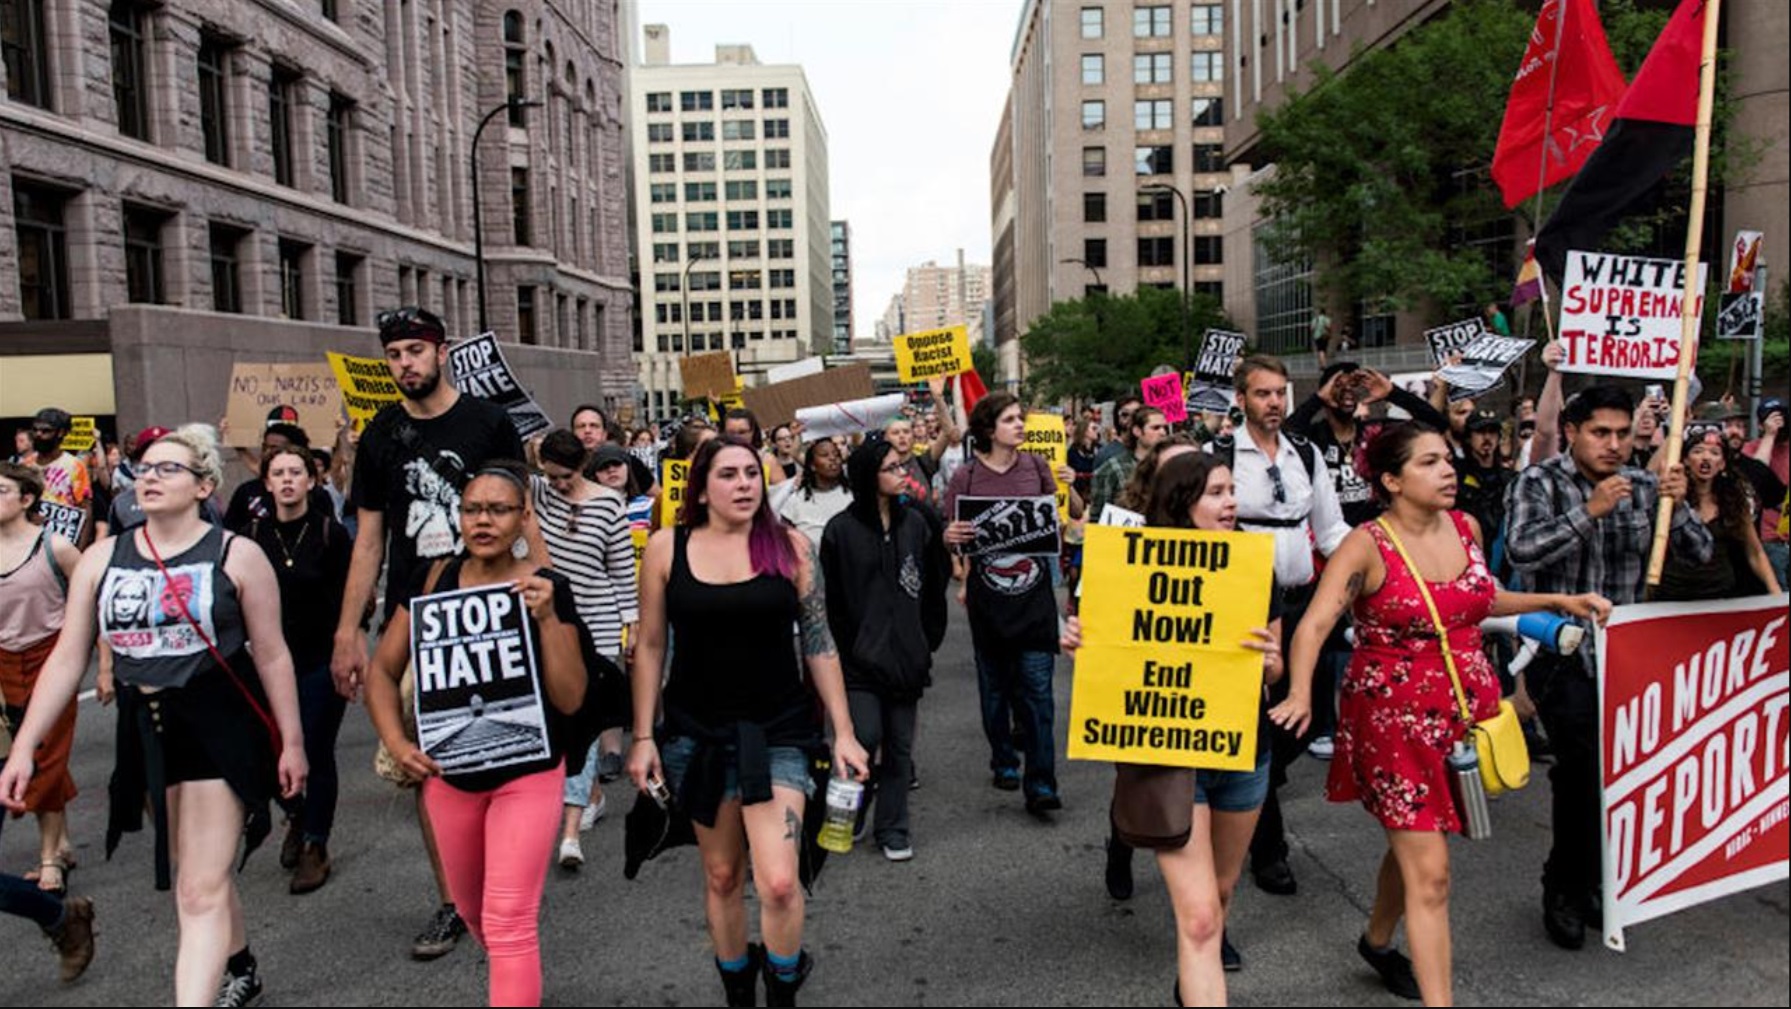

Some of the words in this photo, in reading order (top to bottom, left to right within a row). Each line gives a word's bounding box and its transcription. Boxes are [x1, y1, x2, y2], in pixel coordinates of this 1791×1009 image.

[1581, 255, 1687, 289] WHITE
[1433, 323, 1478, 350] STOP
[1605, 315, 1641, 336] IS
[907, 331, 955, 350] Oppose
[913, 346, 952, 363] Racist
[1207, 334, 1244, 354] STOP
[1561, 330, 1697, 369] TERRORIS
[453, 340, 493, 375] STOP
[233, 375, 259, 395] NO
[323, 376, 337, 391] O
[352, 376, 397, 395] White
[1148, 379, 1176, 402] NOT
[1025, 428, 1063, 444] esota
[39, 502, 79, 521] STOP
[45, 520, 77, 541] ATE
[1124, 531, 1230, 573] Trump
[1149, 571, 1204, 606] Out
[421, 592, 513, 642] STOP
[1132, 609, 1213, 644] Now!
[419, 636, 526, 693] HATE
[1143, 660, 1192, 689] End
[1124, 690, 1206, 720] White
[1613, 681, 1661, 775] NO
[1672, 615, 1787, 733] MORE
[1083, 717, 1243, 757] Supremacy
[1610, 692, 1789, 901] DEPORT
